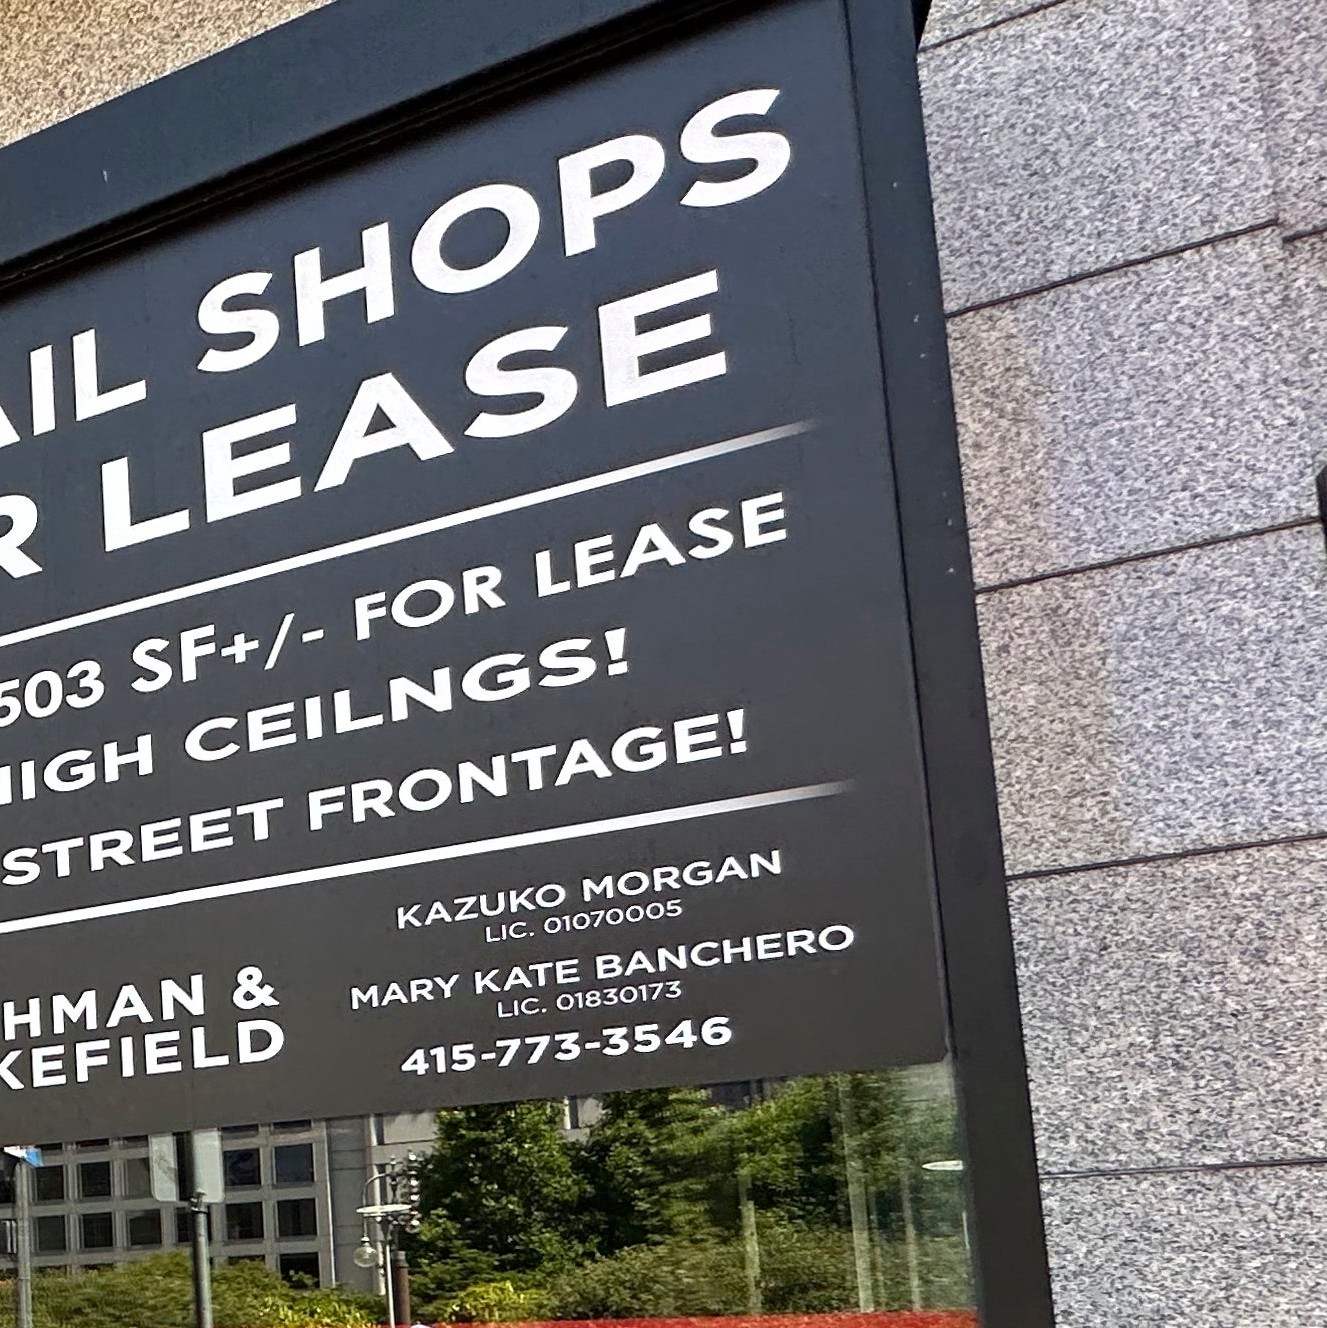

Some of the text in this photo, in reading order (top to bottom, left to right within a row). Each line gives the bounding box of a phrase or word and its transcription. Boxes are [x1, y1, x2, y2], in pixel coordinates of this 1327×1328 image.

[195, 86, 793, 373] SHOPS
[100, 268, 729, 554] LEASE
[130, 611, 325, 694] SF+/-
[353, 566, 507, 642] FOR
[534, 491, 788, 599] LEASE
[183, 626, 630, 762] CEILNGS!
[0, 797, 285, 887] STREET
[307, 707, 749, 833] FRONTAGE!
[396, 848, 783, 931] KAZUKO MORGAN
[484, 899, 683, 944] LIC. 01070005
[231, 964, 280, 1010] &
[349, 923, 856, 1011] MARY KATE BANCHERO
[497, 979, 683, 1019] LIC. 01830173
[399, 1015, 734, 1077] 415-773-3546
